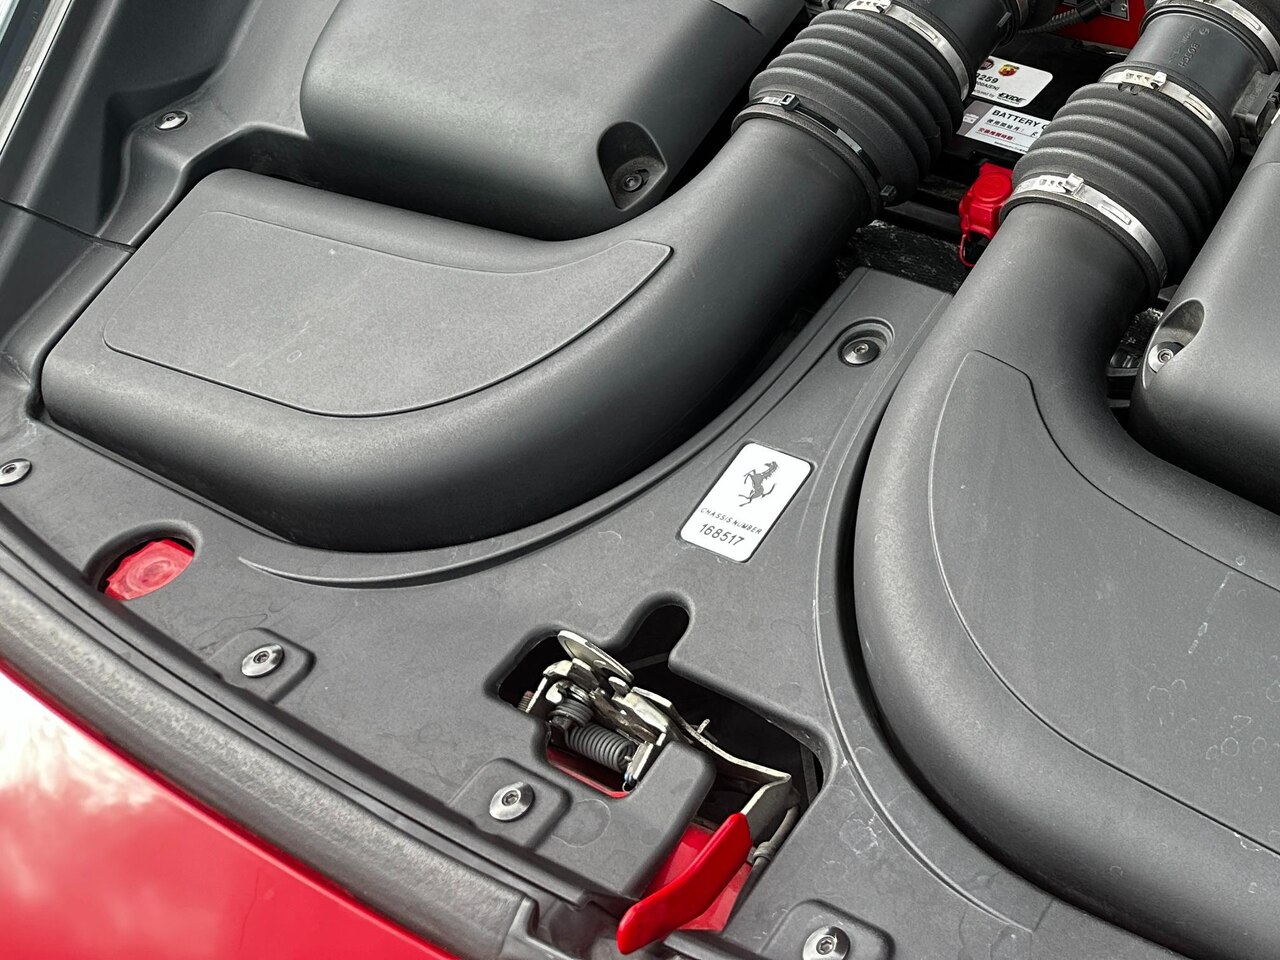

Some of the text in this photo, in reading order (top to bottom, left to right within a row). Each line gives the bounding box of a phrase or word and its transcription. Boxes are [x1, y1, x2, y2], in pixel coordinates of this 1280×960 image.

[1178, 43, 1200, 68] BOSCH
[998, 92, 1026, 103] EXIDE
[992, 109, 1040, 128] BATTERY
[700, 507, 763, 535] CHASSIS NUMBER
[699, 523, 745, 546] 168517
